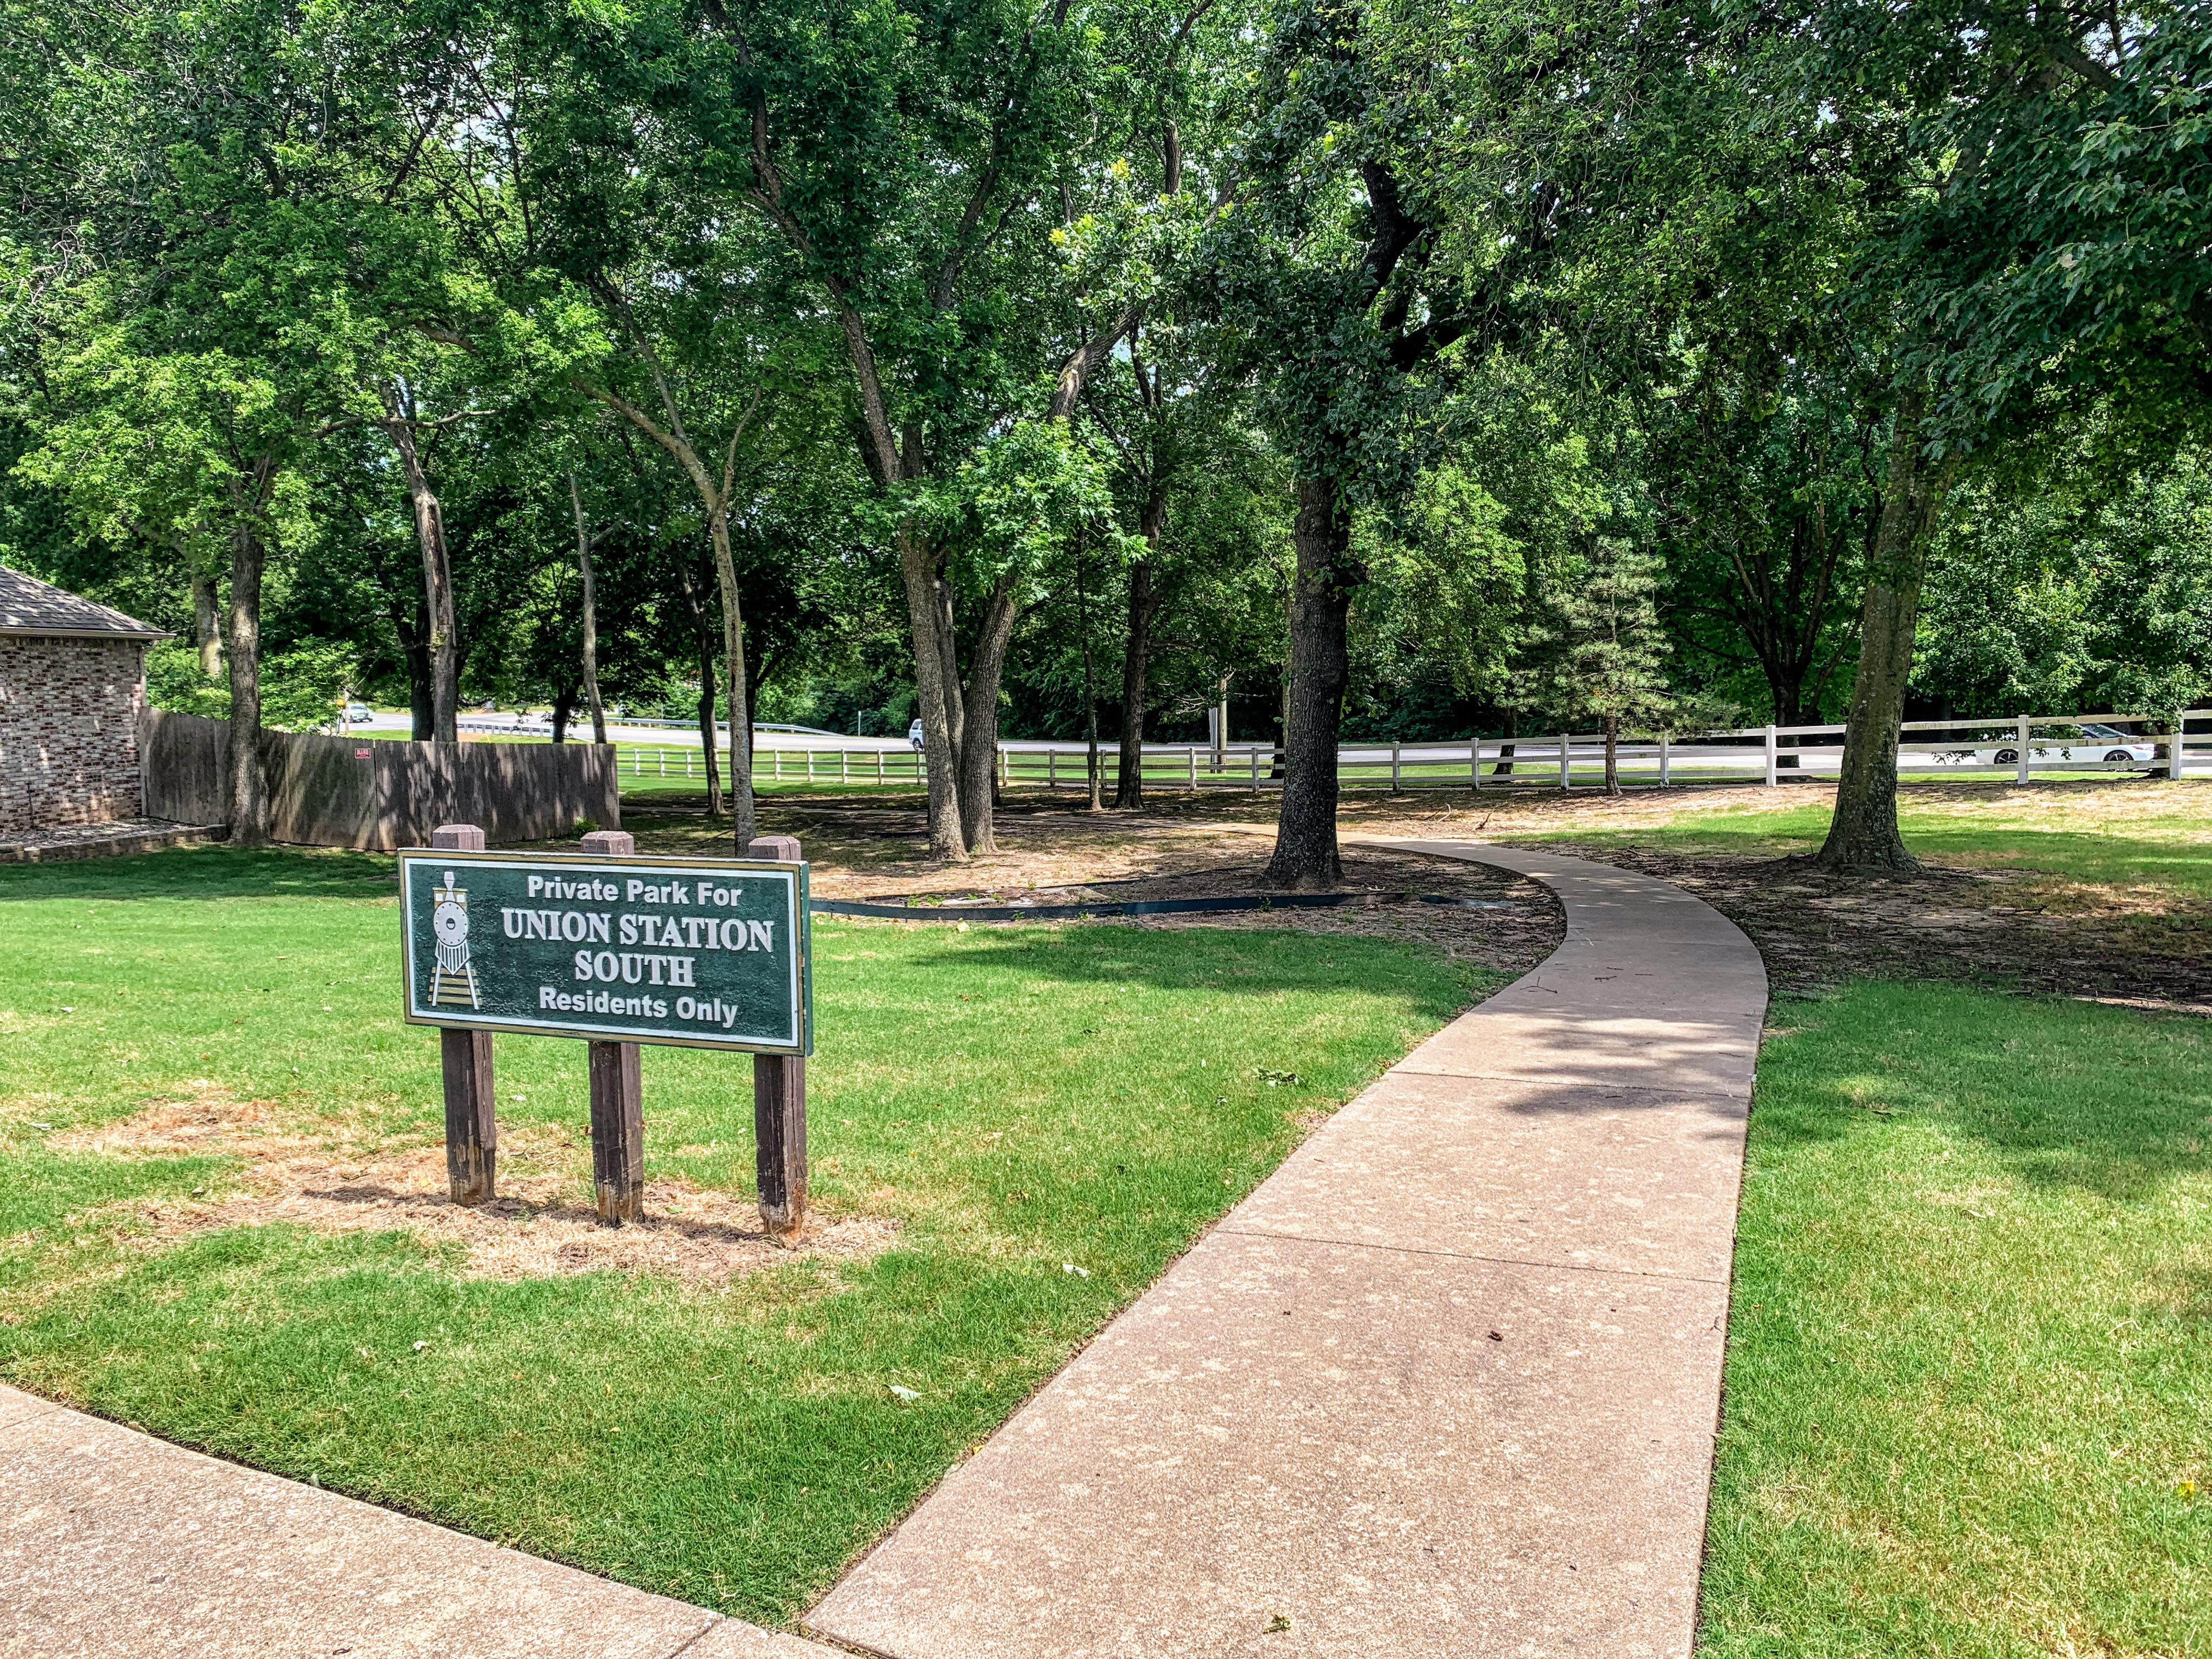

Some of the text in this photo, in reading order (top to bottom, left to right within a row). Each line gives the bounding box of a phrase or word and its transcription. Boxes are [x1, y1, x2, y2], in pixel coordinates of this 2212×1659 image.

[528, 876, 742, 906] Private Park For
[501, 909, 774, 952] UNION STATION
[575, 950, 696, 987] SOUTH
[540, 988, 738, 1027] Residents Only
